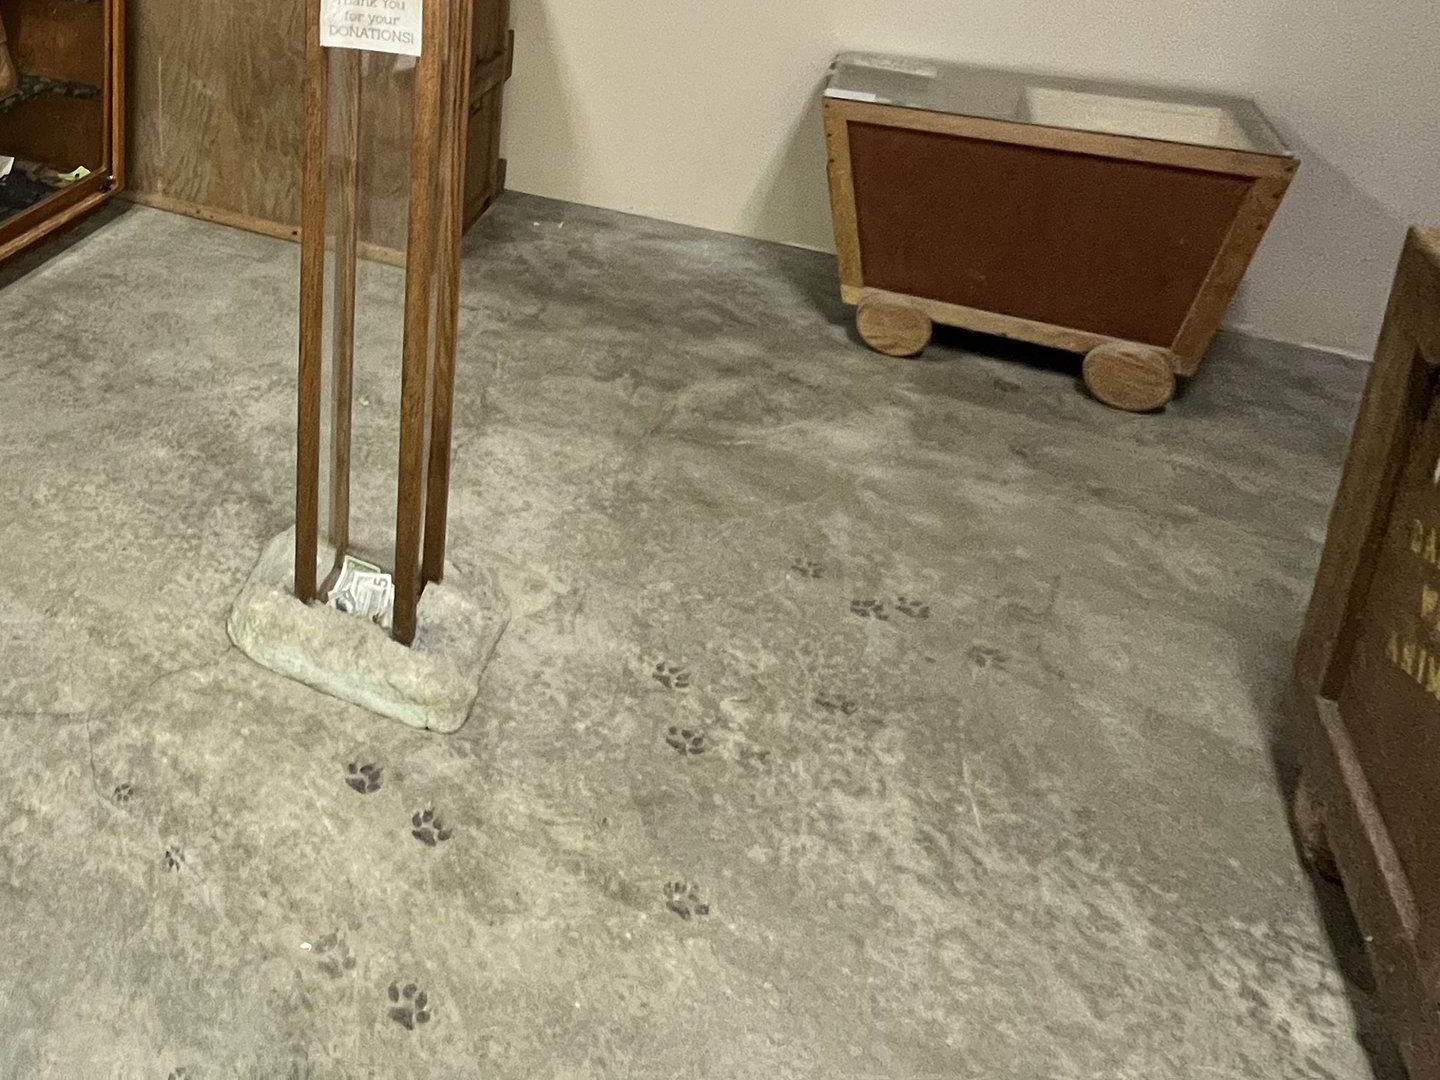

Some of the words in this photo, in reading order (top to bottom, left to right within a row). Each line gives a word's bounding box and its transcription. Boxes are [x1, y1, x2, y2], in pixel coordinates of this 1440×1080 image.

[344, 10, 364, 22] for
[367, 15, 400, 27] your
[329, 24, 414, 45] DONATIONS!
